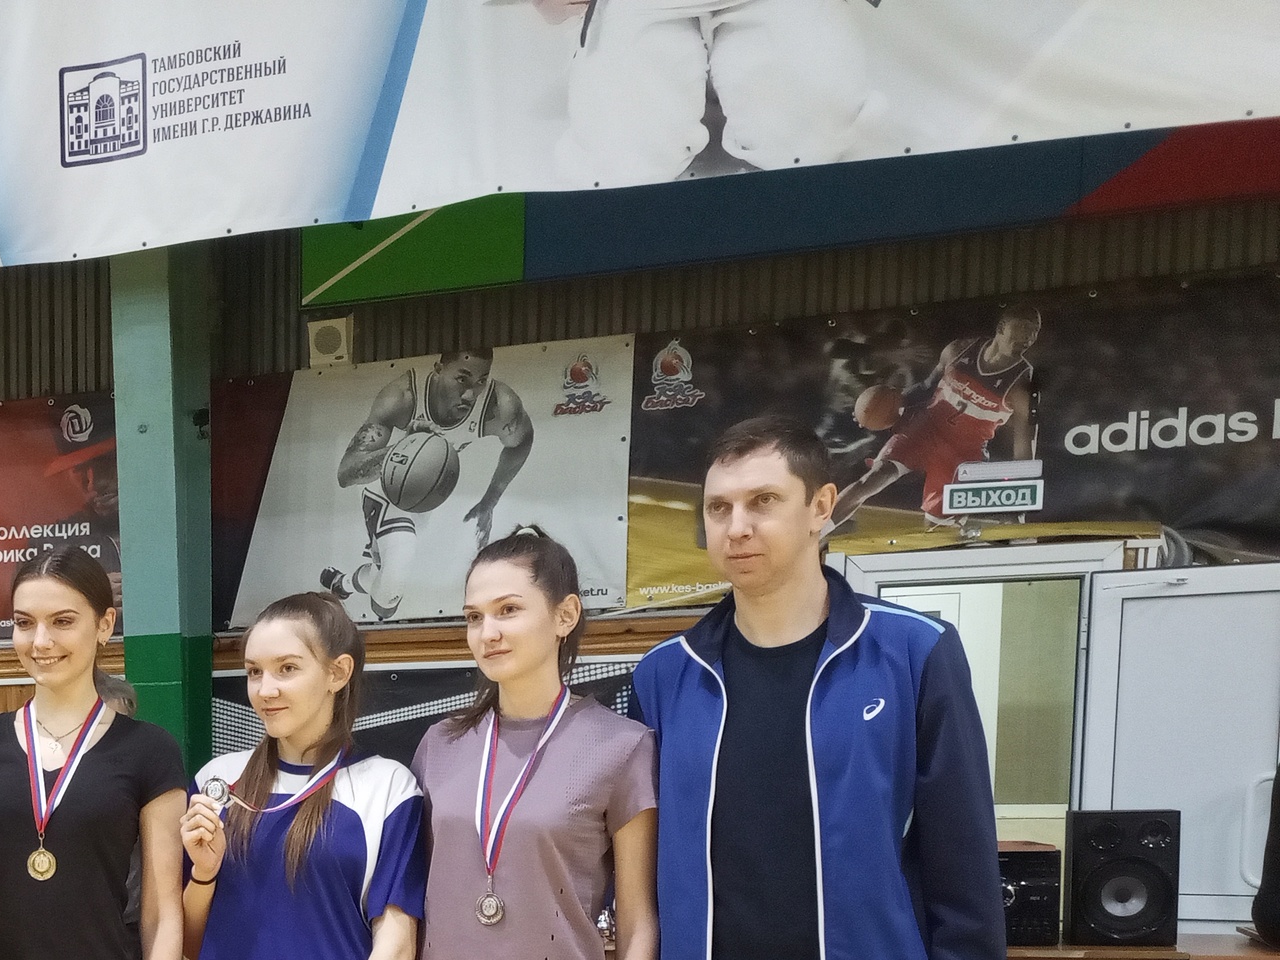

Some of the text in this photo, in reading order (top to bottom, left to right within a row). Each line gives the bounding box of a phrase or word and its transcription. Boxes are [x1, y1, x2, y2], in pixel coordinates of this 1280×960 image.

[152, 40, 242, 74] ТАМБОВСКИЙ
[152, 56, 287, 97] ГОСУДАРСТВЕННЫЙ
[152, 88, 246, 121] УНИВЕРСИТЕТ
[153, 102, 312, 143] ИМЕНИ Г.Р. ДЕРЖАВИНА
[1064, 407, 1259, 456] adidas
[953, 488, 1032, 508] ВЫХОД
